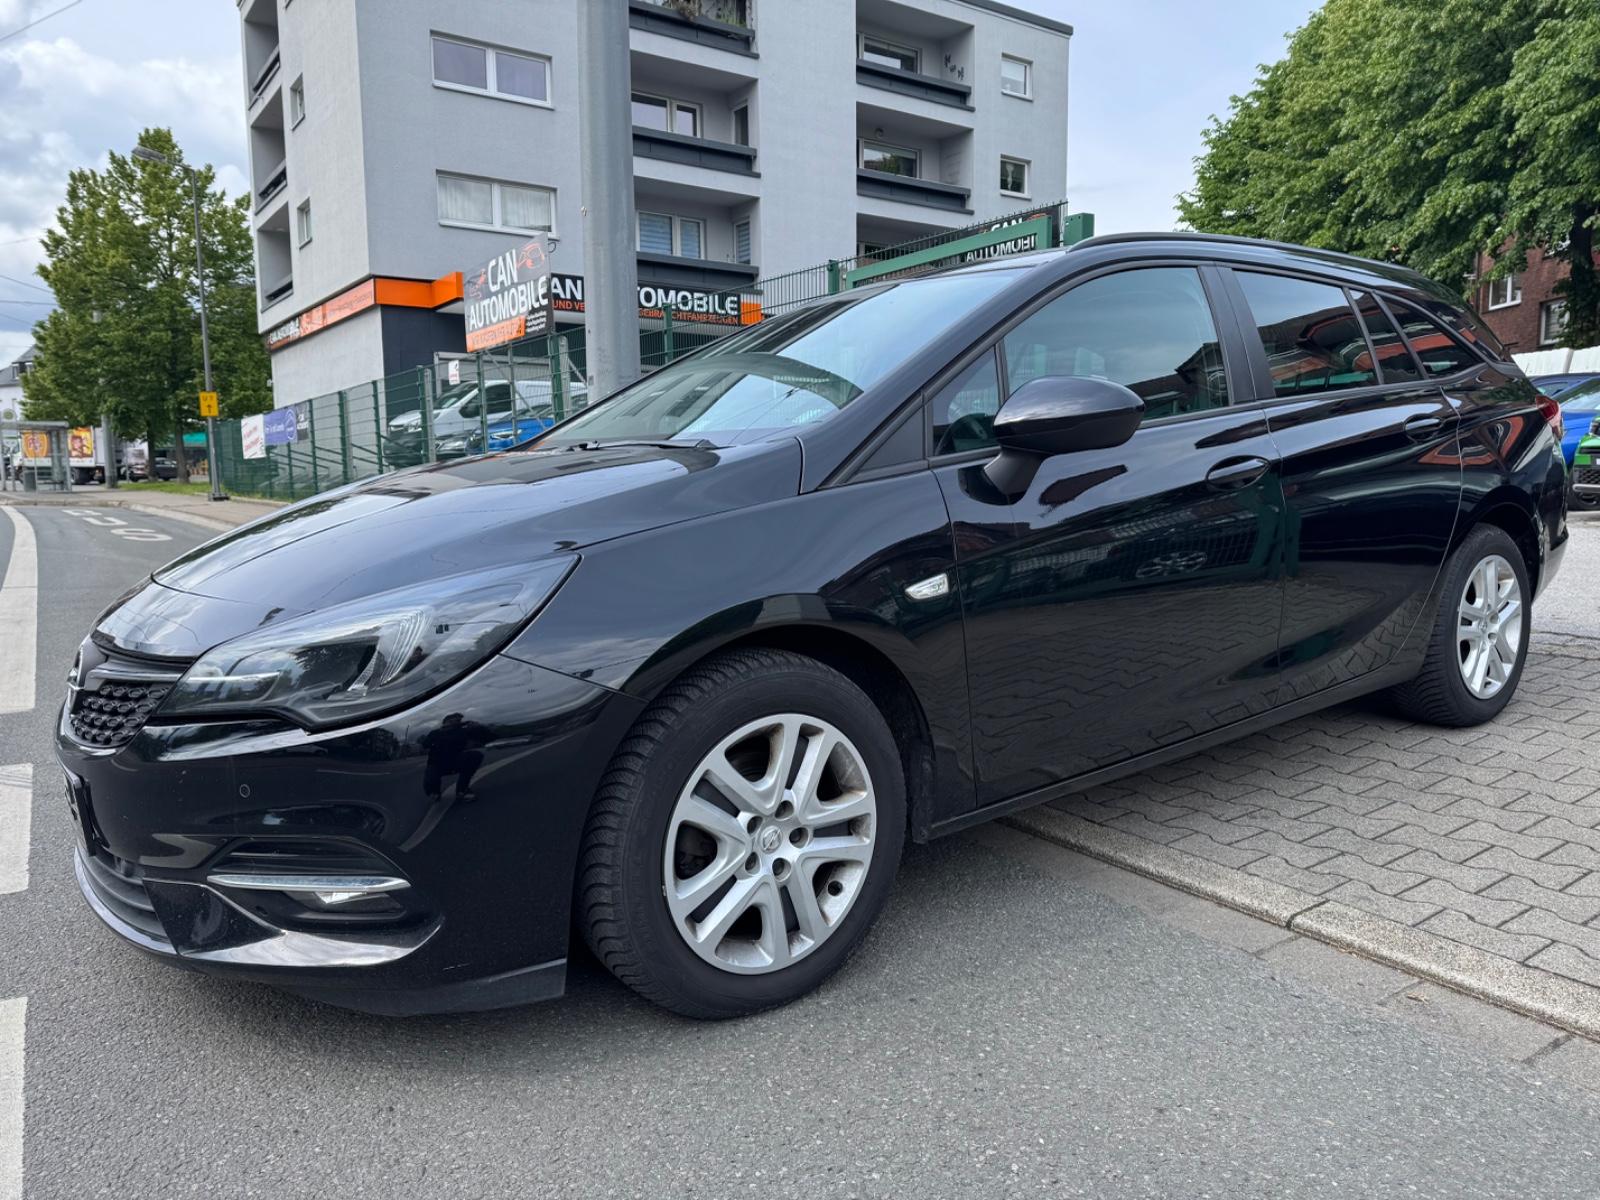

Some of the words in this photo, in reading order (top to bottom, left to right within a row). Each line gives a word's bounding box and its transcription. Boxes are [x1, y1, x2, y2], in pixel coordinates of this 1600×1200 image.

[487, 249, 518, 292] CAN
[469, 276, 548, 331] AUTOMOBILE
[551, 277, 583, 300] AN
[637, 286, 738, 316] OMOBILE
[61, 509, 173, 541] BUS
